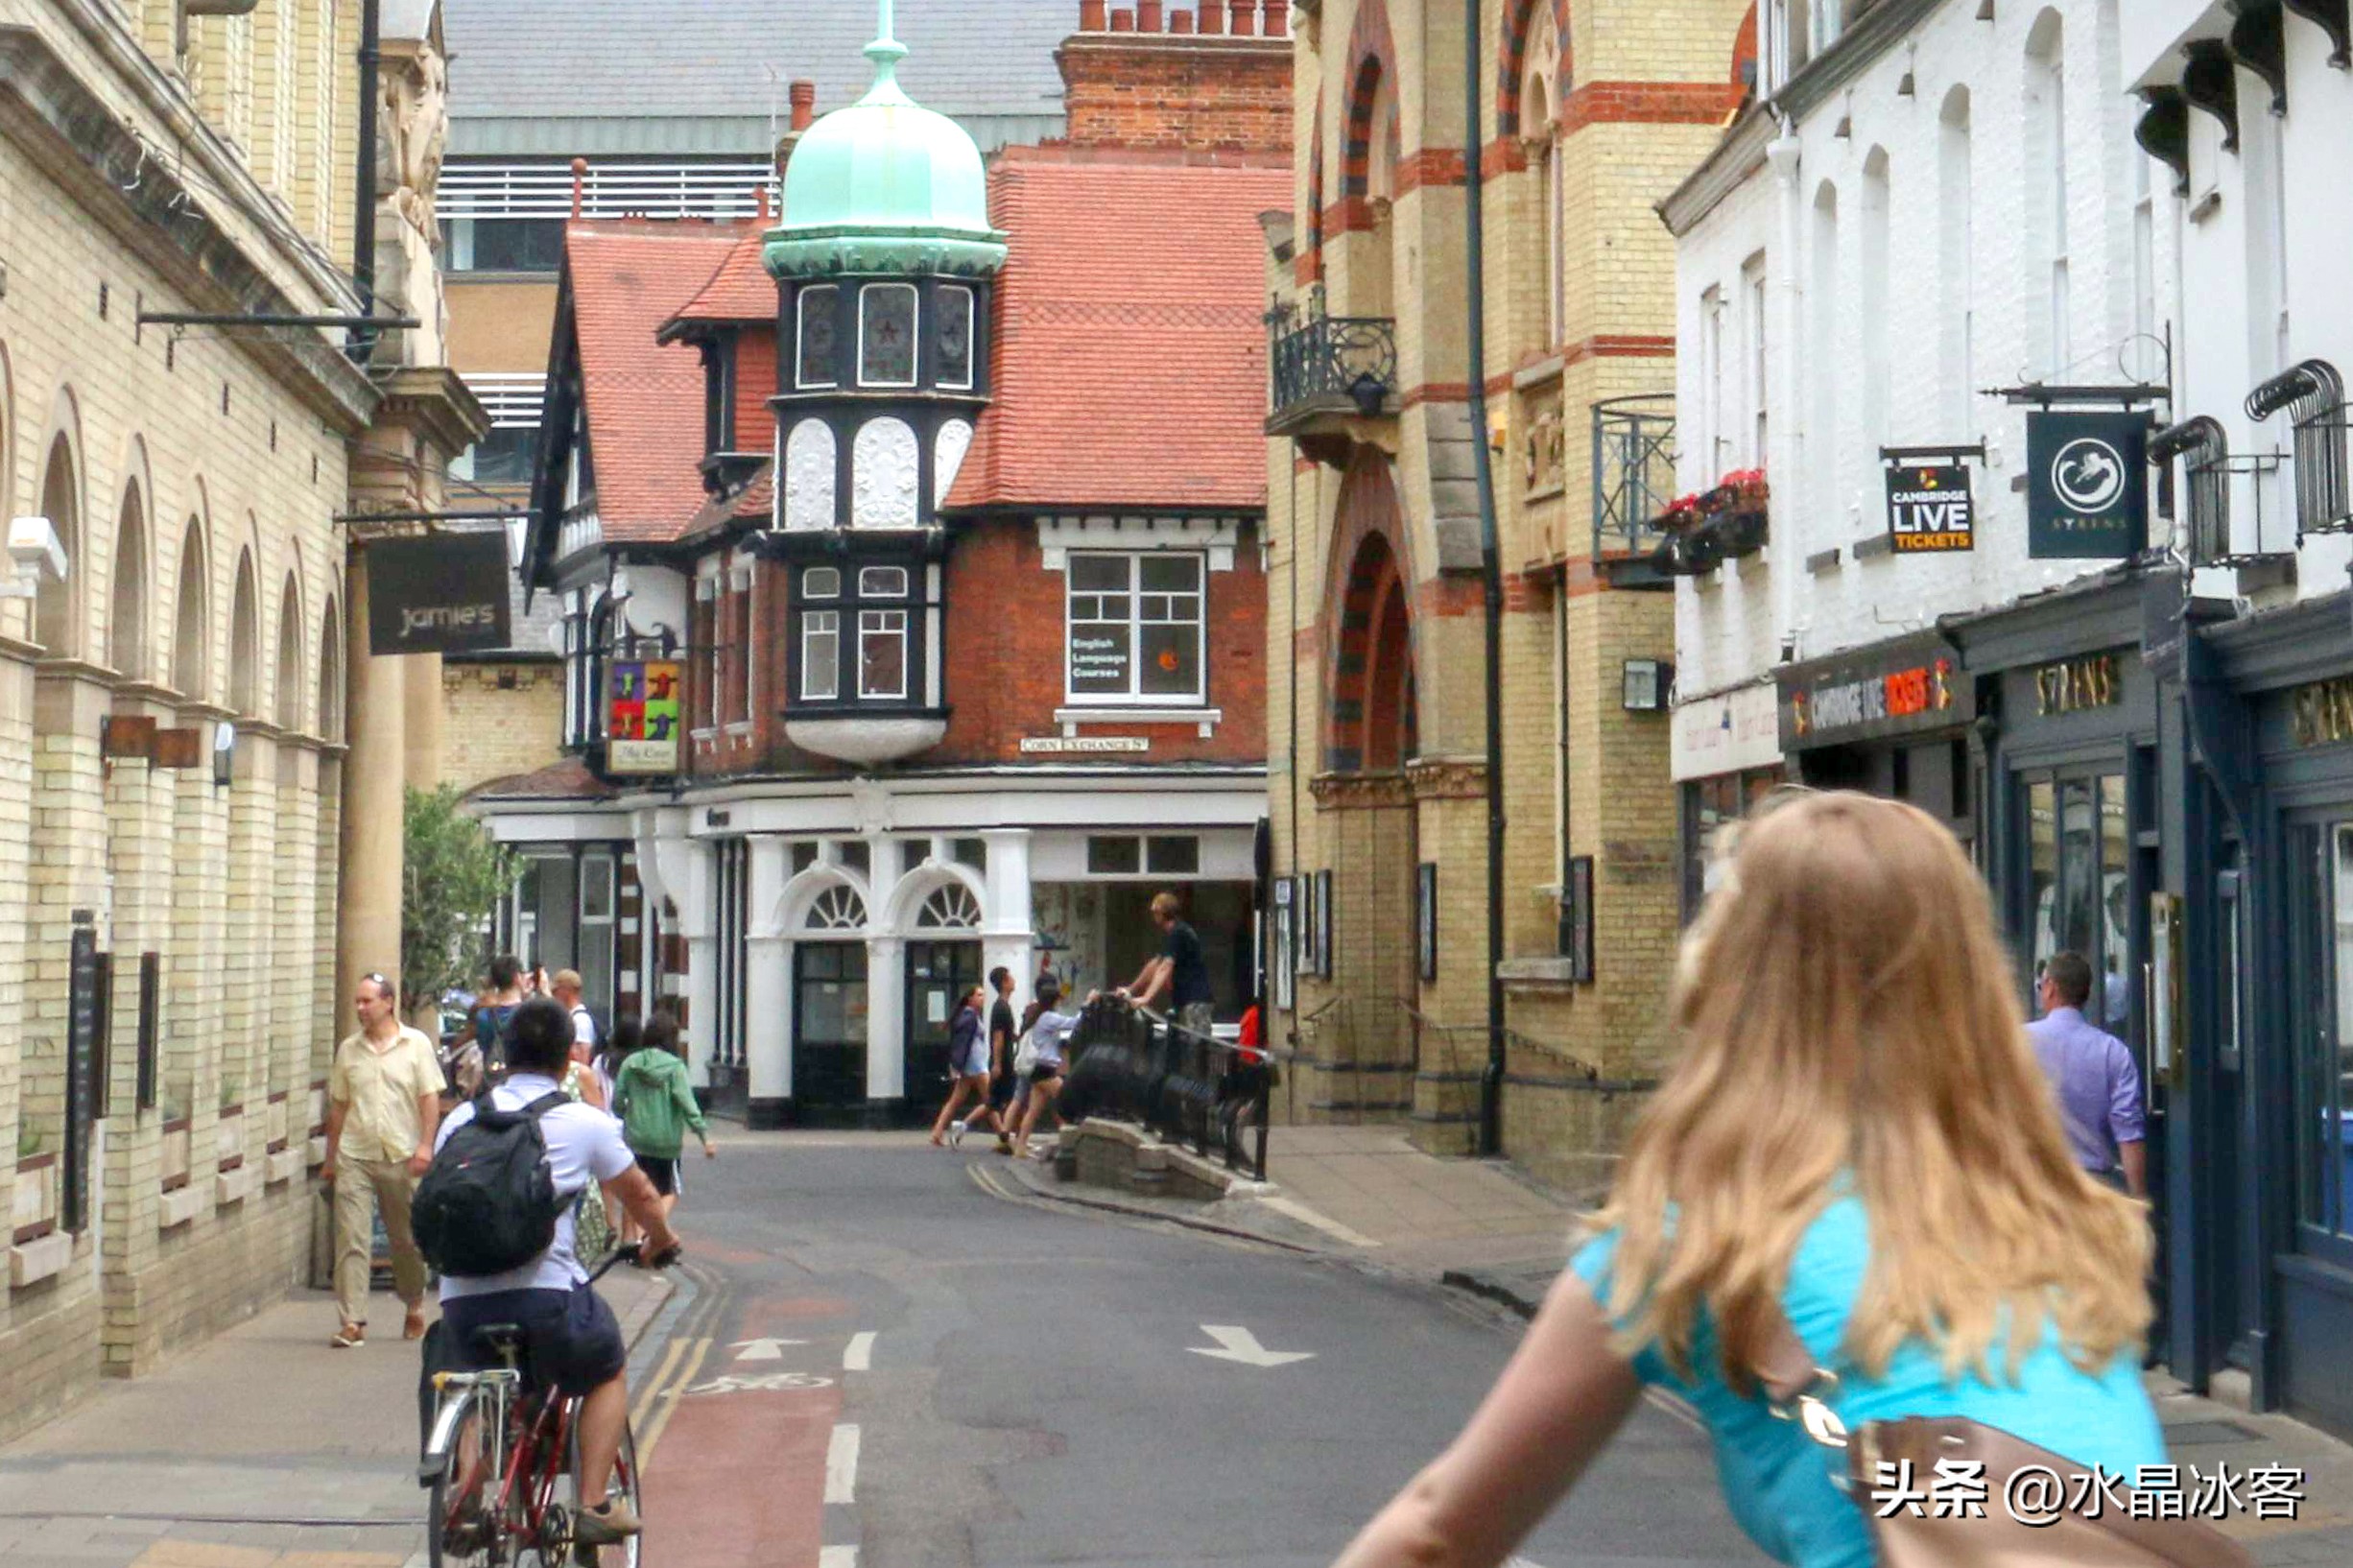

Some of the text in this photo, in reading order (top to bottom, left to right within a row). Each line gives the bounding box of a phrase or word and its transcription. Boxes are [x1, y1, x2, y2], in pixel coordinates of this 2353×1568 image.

[1891, 490, 1966, 503] CAMBRIDGE
[1891, 504, 1969, 533] LIVE
[1895, 533, 1969, 548] TICKETS
[1072, 638, 1114, 650] English
[1072, 653, 1128, 665] Language
[1072, 667, 1120, 677] Courses
